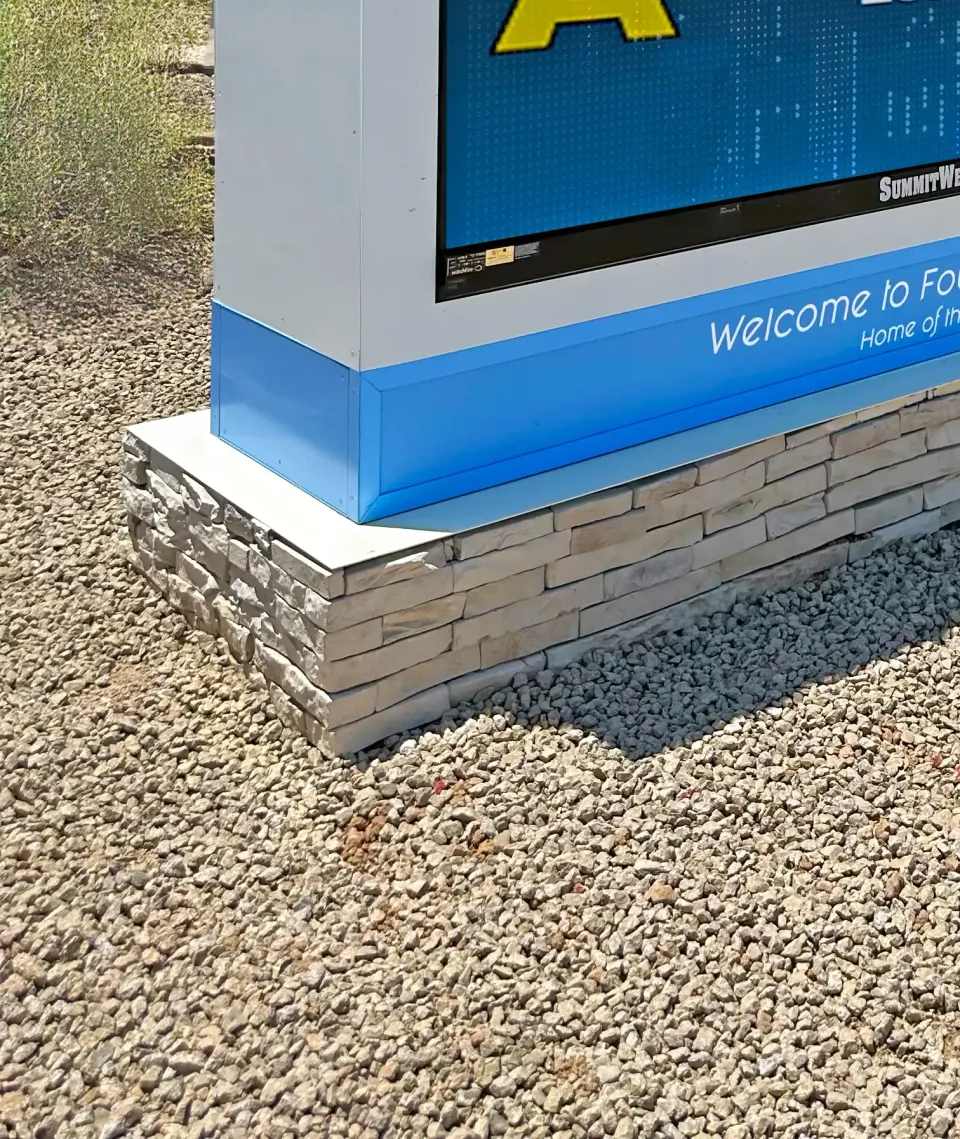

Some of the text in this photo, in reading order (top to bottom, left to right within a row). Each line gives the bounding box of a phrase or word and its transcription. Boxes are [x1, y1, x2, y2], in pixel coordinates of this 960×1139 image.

[709, 288, 871, 354] Welcome
[881, 279, 909, 310] to
[860, 322, 915, 350] Home
[922, 310, 942, 338] of
